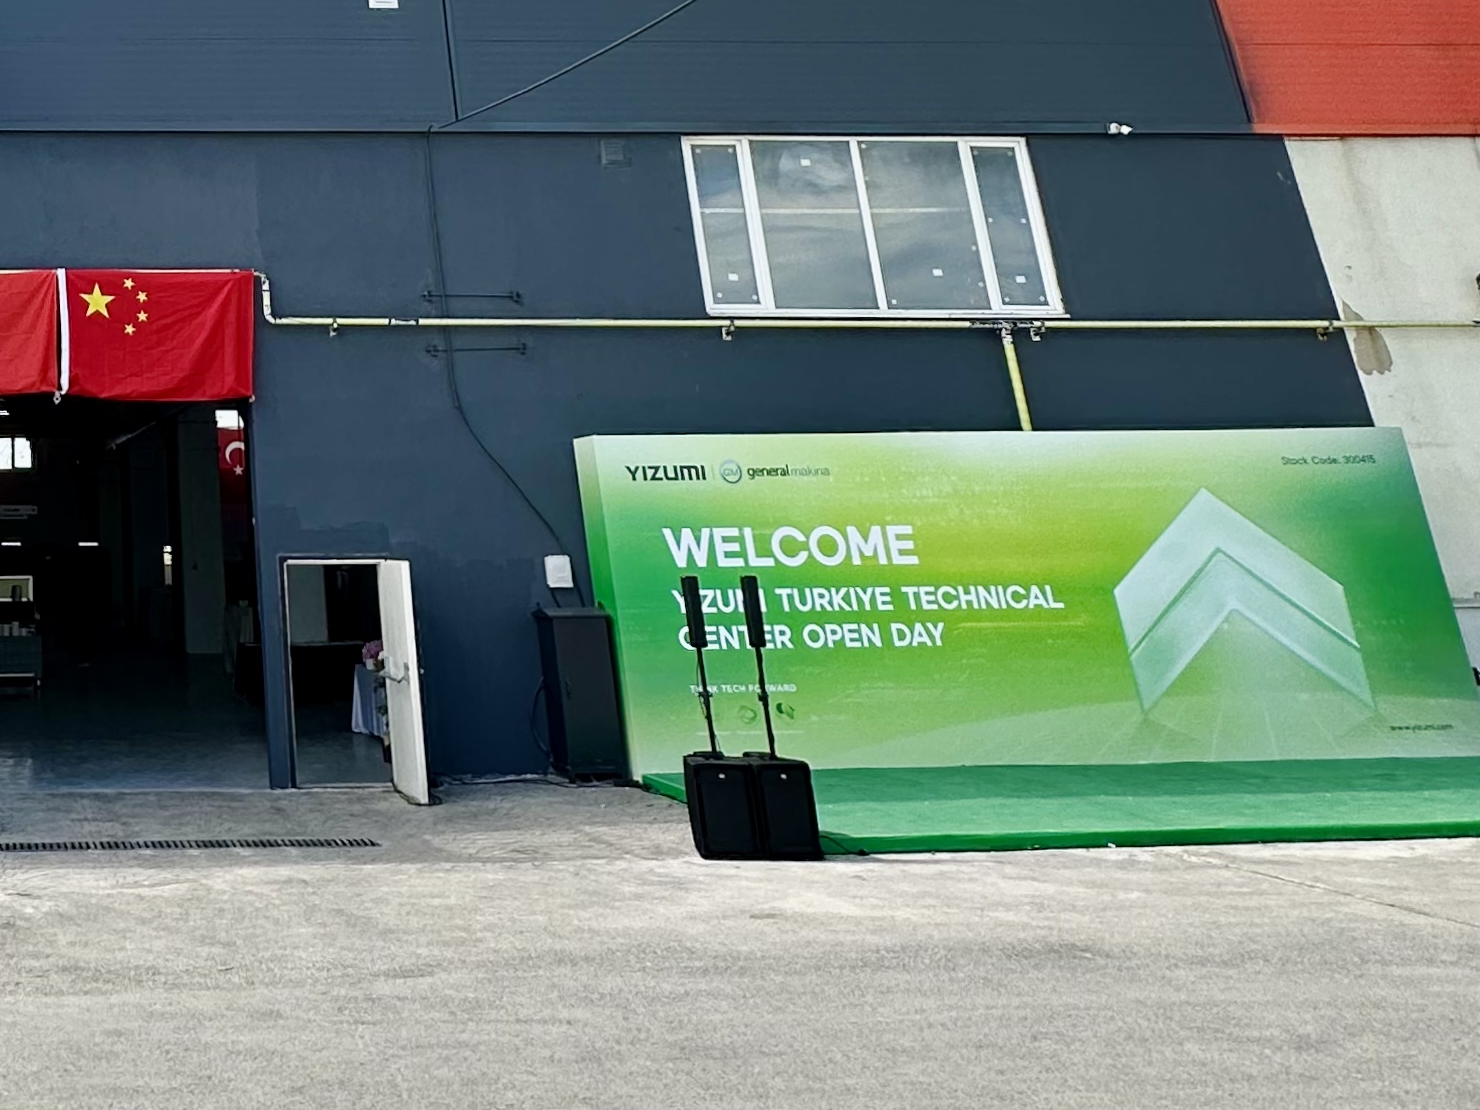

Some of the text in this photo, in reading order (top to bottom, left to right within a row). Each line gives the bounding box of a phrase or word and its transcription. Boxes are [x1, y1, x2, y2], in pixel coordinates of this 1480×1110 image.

[1281, 455, 1308, 466] Stock
[624, 464, 707, 482] YIZUMI
[661, 524, 920, 569] WELCOME
[671, 584, 1065, 614] YZUI TURKIYE TECHNICAL
[802, 622, 883, 649] OPEN
[890, 621, 944, 647] DAY
[721, 684, 746, 693] TECH
[748, 683, 797, 693] FOWARD
